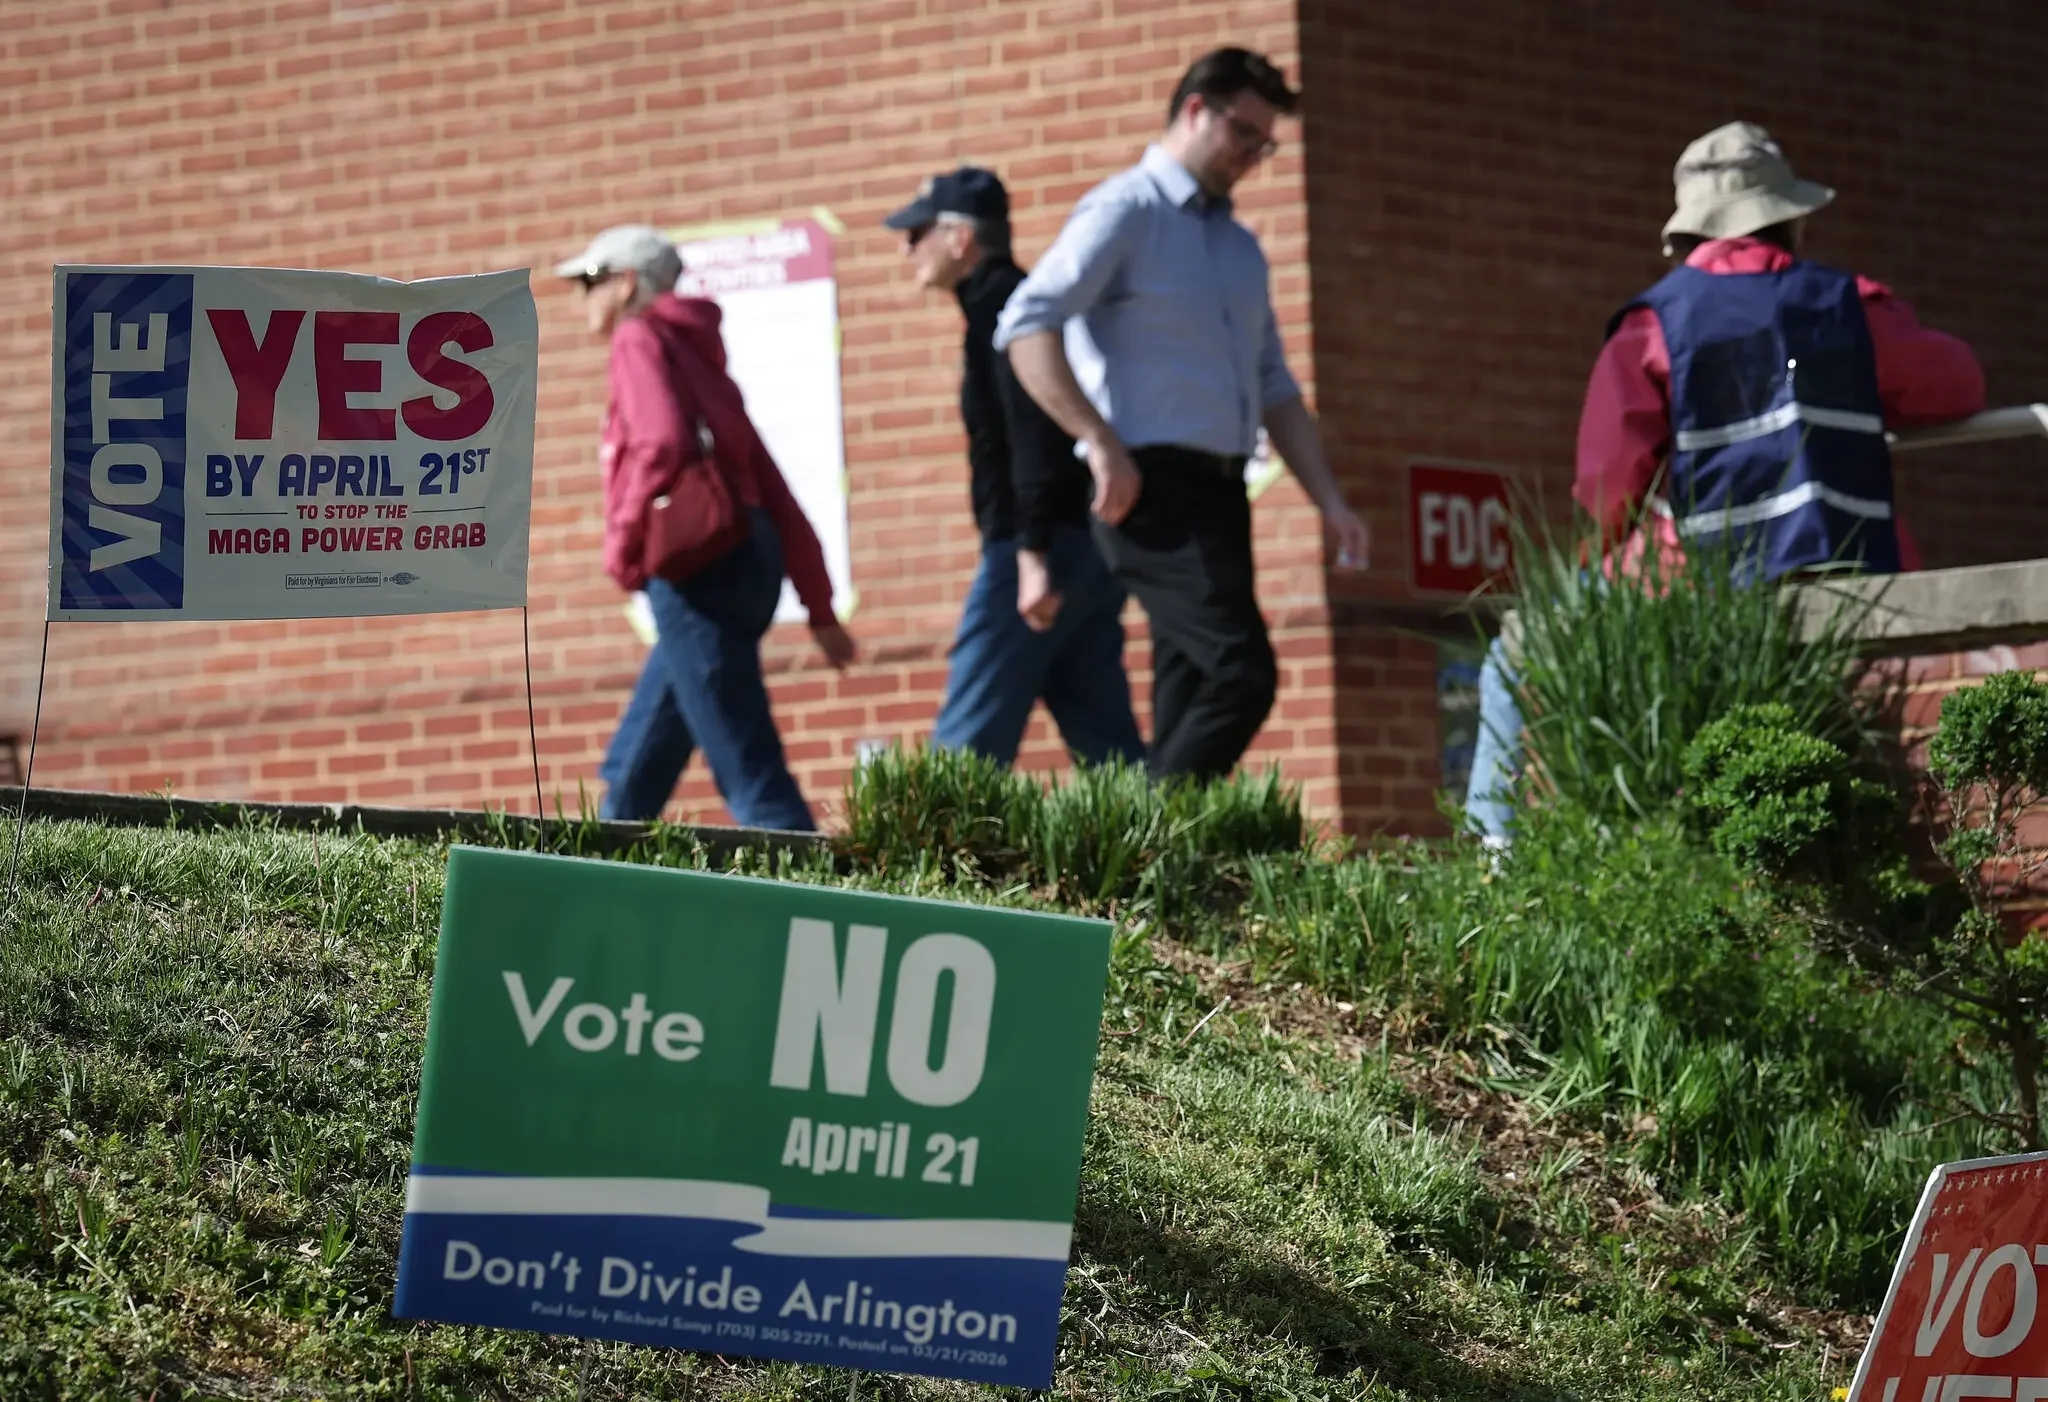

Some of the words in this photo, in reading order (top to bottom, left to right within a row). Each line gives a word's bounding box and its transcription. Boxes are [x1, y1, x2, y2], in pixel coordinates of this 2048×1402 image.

[206, 309, 495, 441] YES
[88, 312, 168, 573] VOTE
[206, 455, 265, 497] BY
[278, 454, 404, 497] APRIL
[419, 448, 491, 496] 21ST
[208, 529, 290, 554] MAGA
[301, 527, 404, 553] POWER
[414, 523, 487, 550] GRAB
[296, 505, 319, 520] TO
[324, 505, 369, 519] STOP
[375, 504, 408, 519] THE
[1419, 489, 1507, 570] FDC
[288, 576, 299, 586] Paid
[315, 576, 338, 586] Virginians
[347, 575, 356, 584] Fair
[356, 574, 379, 584] Elections
[501, 971, 703, 1062] Vote
[769, 917, 997, 1107] NO
[781, 1117, 911, 1178] April
[921, 1132, 980, 1187] 21
[443, 1240, 581, 1293] Don't
[599, 1257, 762, 1315] Divide
[779, 1279, 1017, 1344] Arlington
[531, 1301, 563, 1317] Paid
[566, 1304, 587, 1319] for
[592, 1307, 610, 1323] by
[614, 1309, 669, 1329] Richard
[717, 1321, 756, 1340] (703)
[838, 1336, 888, 1353] Posted
[890, 1341, 909, 1356] on
[1914, 1243, 2048, 1358] VO
